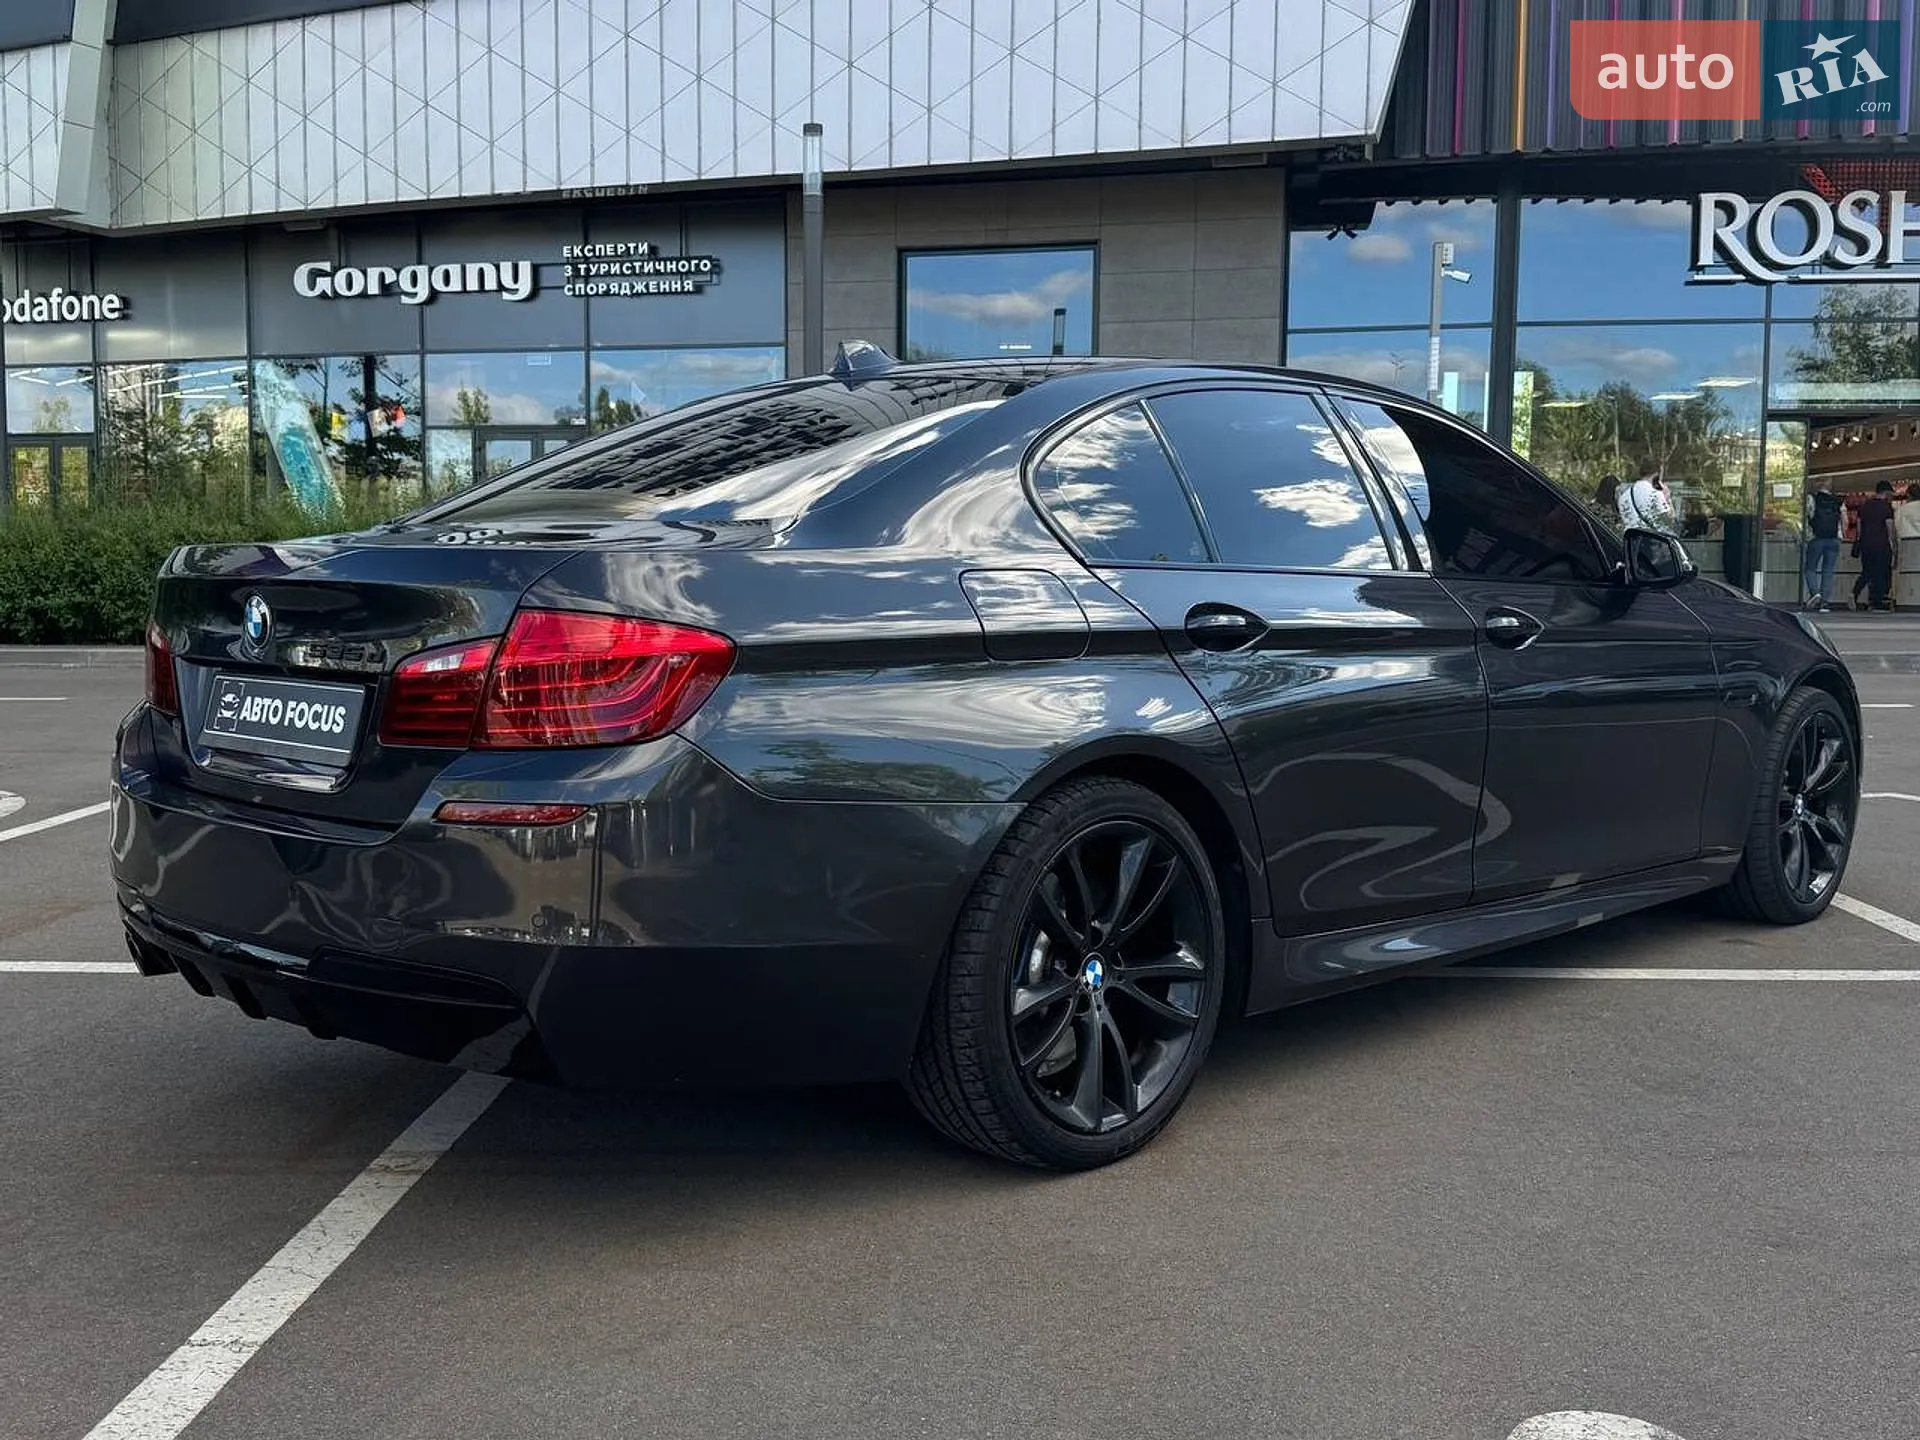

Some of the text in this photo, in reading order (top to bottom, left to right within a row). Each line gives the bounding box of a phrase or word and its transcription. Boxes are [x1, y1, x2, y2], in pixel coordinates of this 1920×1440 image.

[562, 242, 649, 258] ЕКСПЕРТИ
[577, 259, 712, 277] ТУРИСТИЧНОГО
[293, 260, 533, 305] Gorgany
[564, 280, 694, 296] СПОРЯДЖЕННЯ
[284, 701, 346, 733] FOCUS
